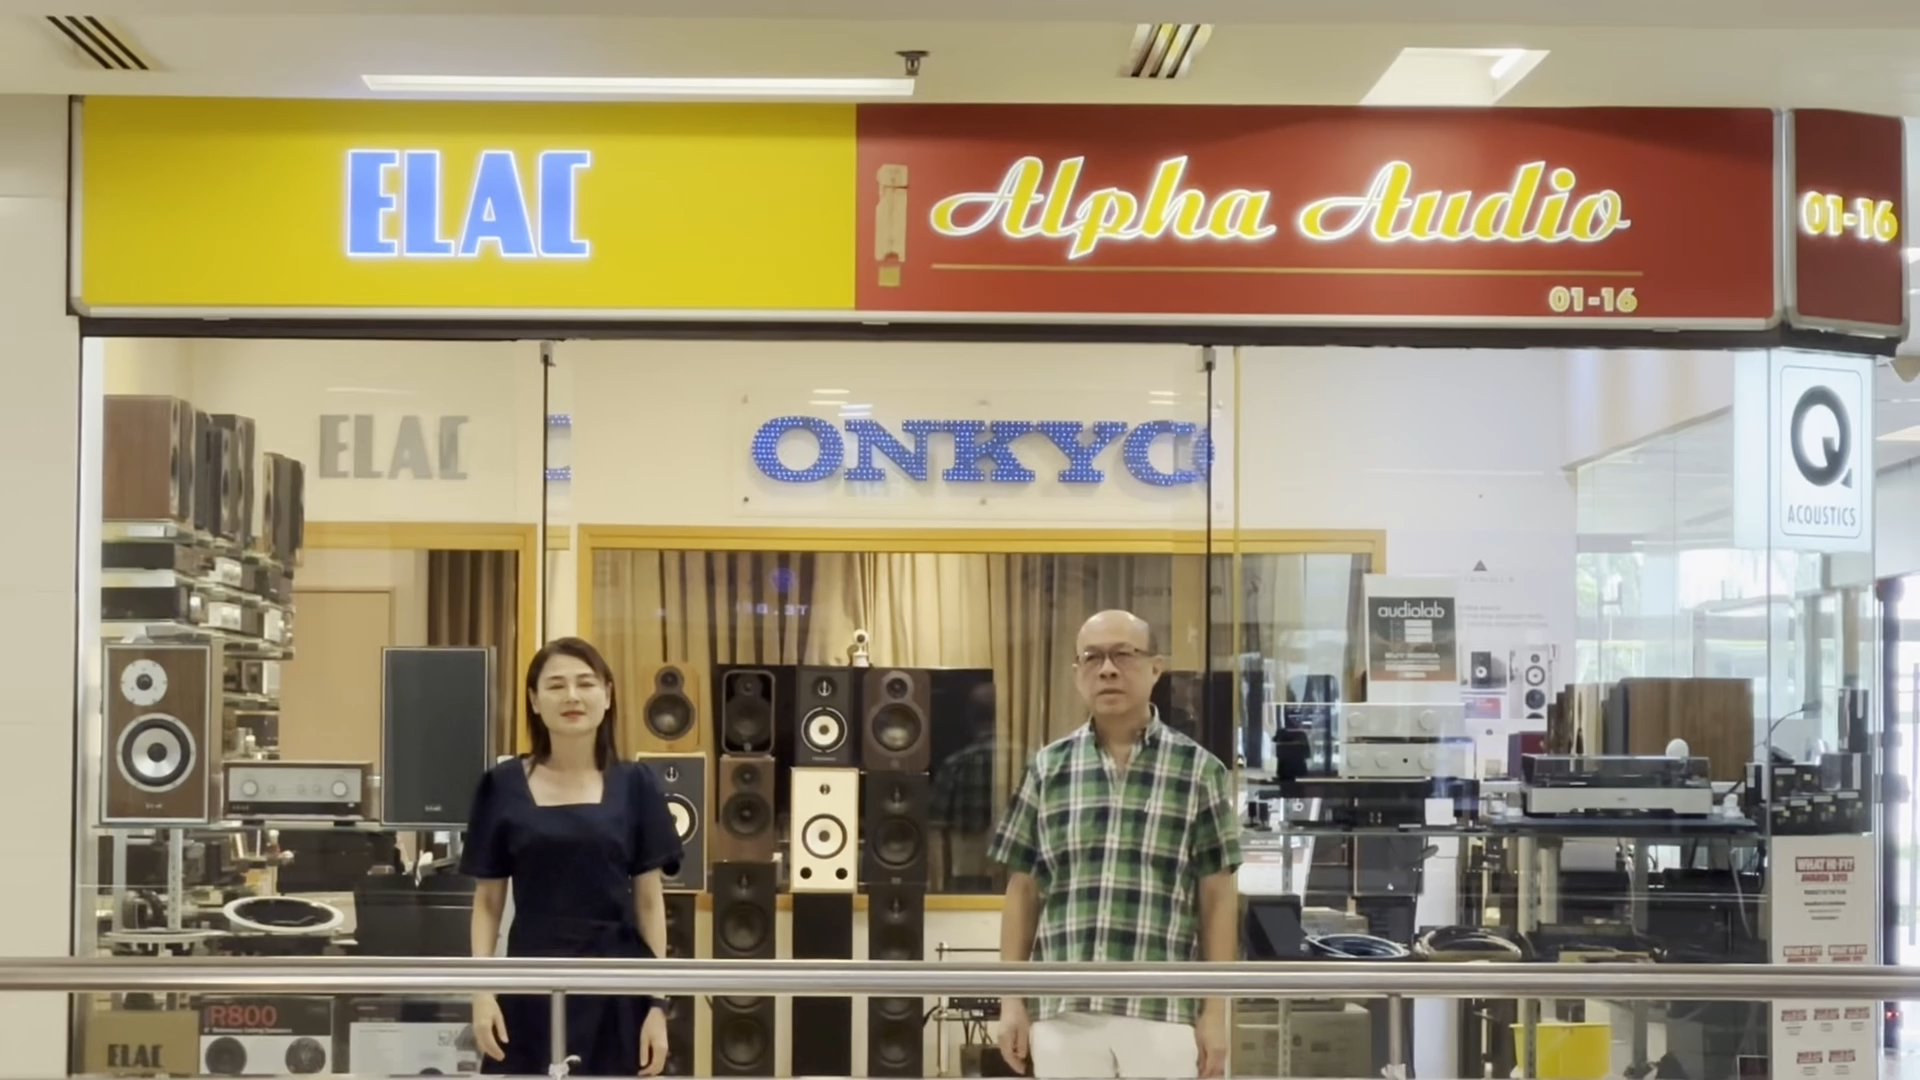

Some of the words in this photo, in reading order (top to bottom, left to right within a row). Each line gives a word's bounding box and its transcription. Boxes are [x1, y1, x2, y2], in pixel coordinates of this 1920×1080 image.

[347, 149, 591, 258] ELAC
[930, 154, 1277, 260] Alpha
[1296, 160, 1632, 244] Audio
[1802, 191, 1898, 242] 01-16
[1548, 286, 1638, 313] 01-16
[318, 414, 469, 480] ELAC
[1791, 385, 1852, 488] Q
[1788, 504, 1857, 527] ACOUSTICS
[1378, 600, 1445, 618] audiolab
[107, 1043, 164, 1068] ELAC
